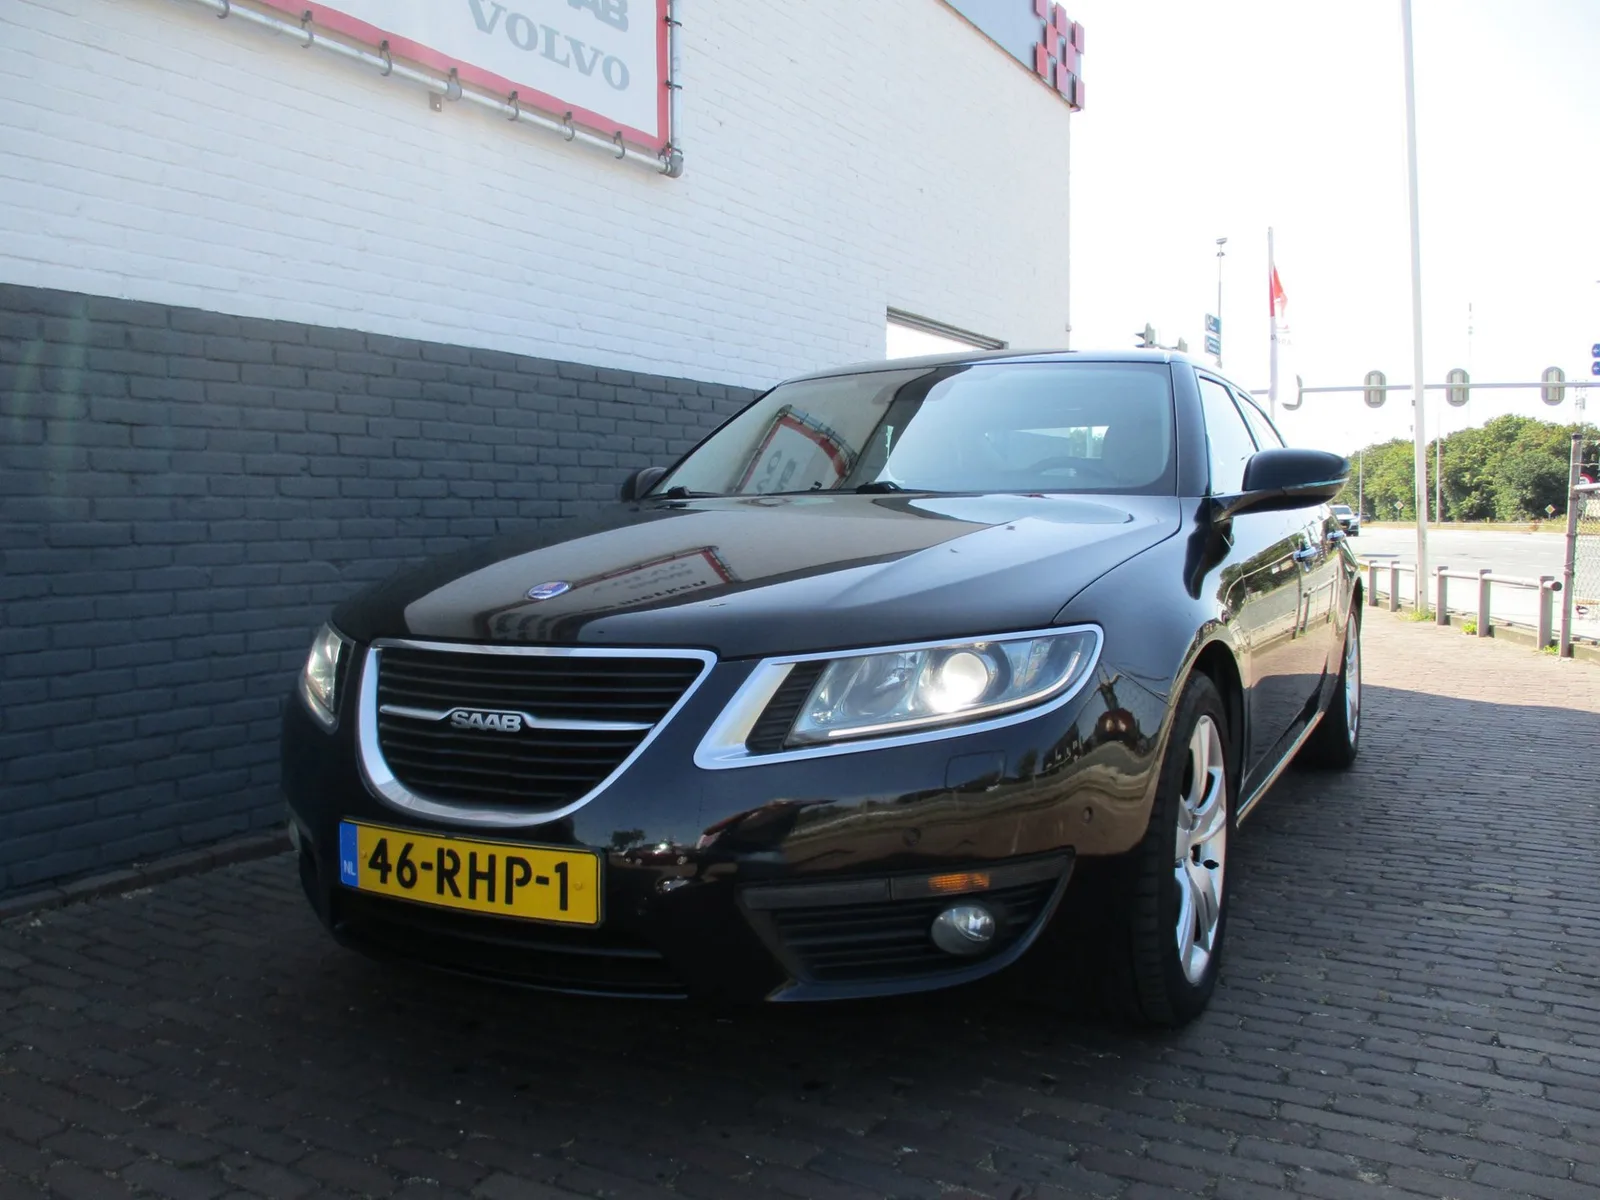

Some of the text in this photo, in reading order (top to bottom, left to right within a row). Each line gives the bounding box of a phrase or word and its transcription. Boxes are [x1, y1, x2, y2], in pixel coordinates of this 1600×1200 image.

[468, 0, 630, 91] VOLVO
[450, 711, 521, 732] SAAB
[343, 838, 568, 911] NL 46-RHP-1
